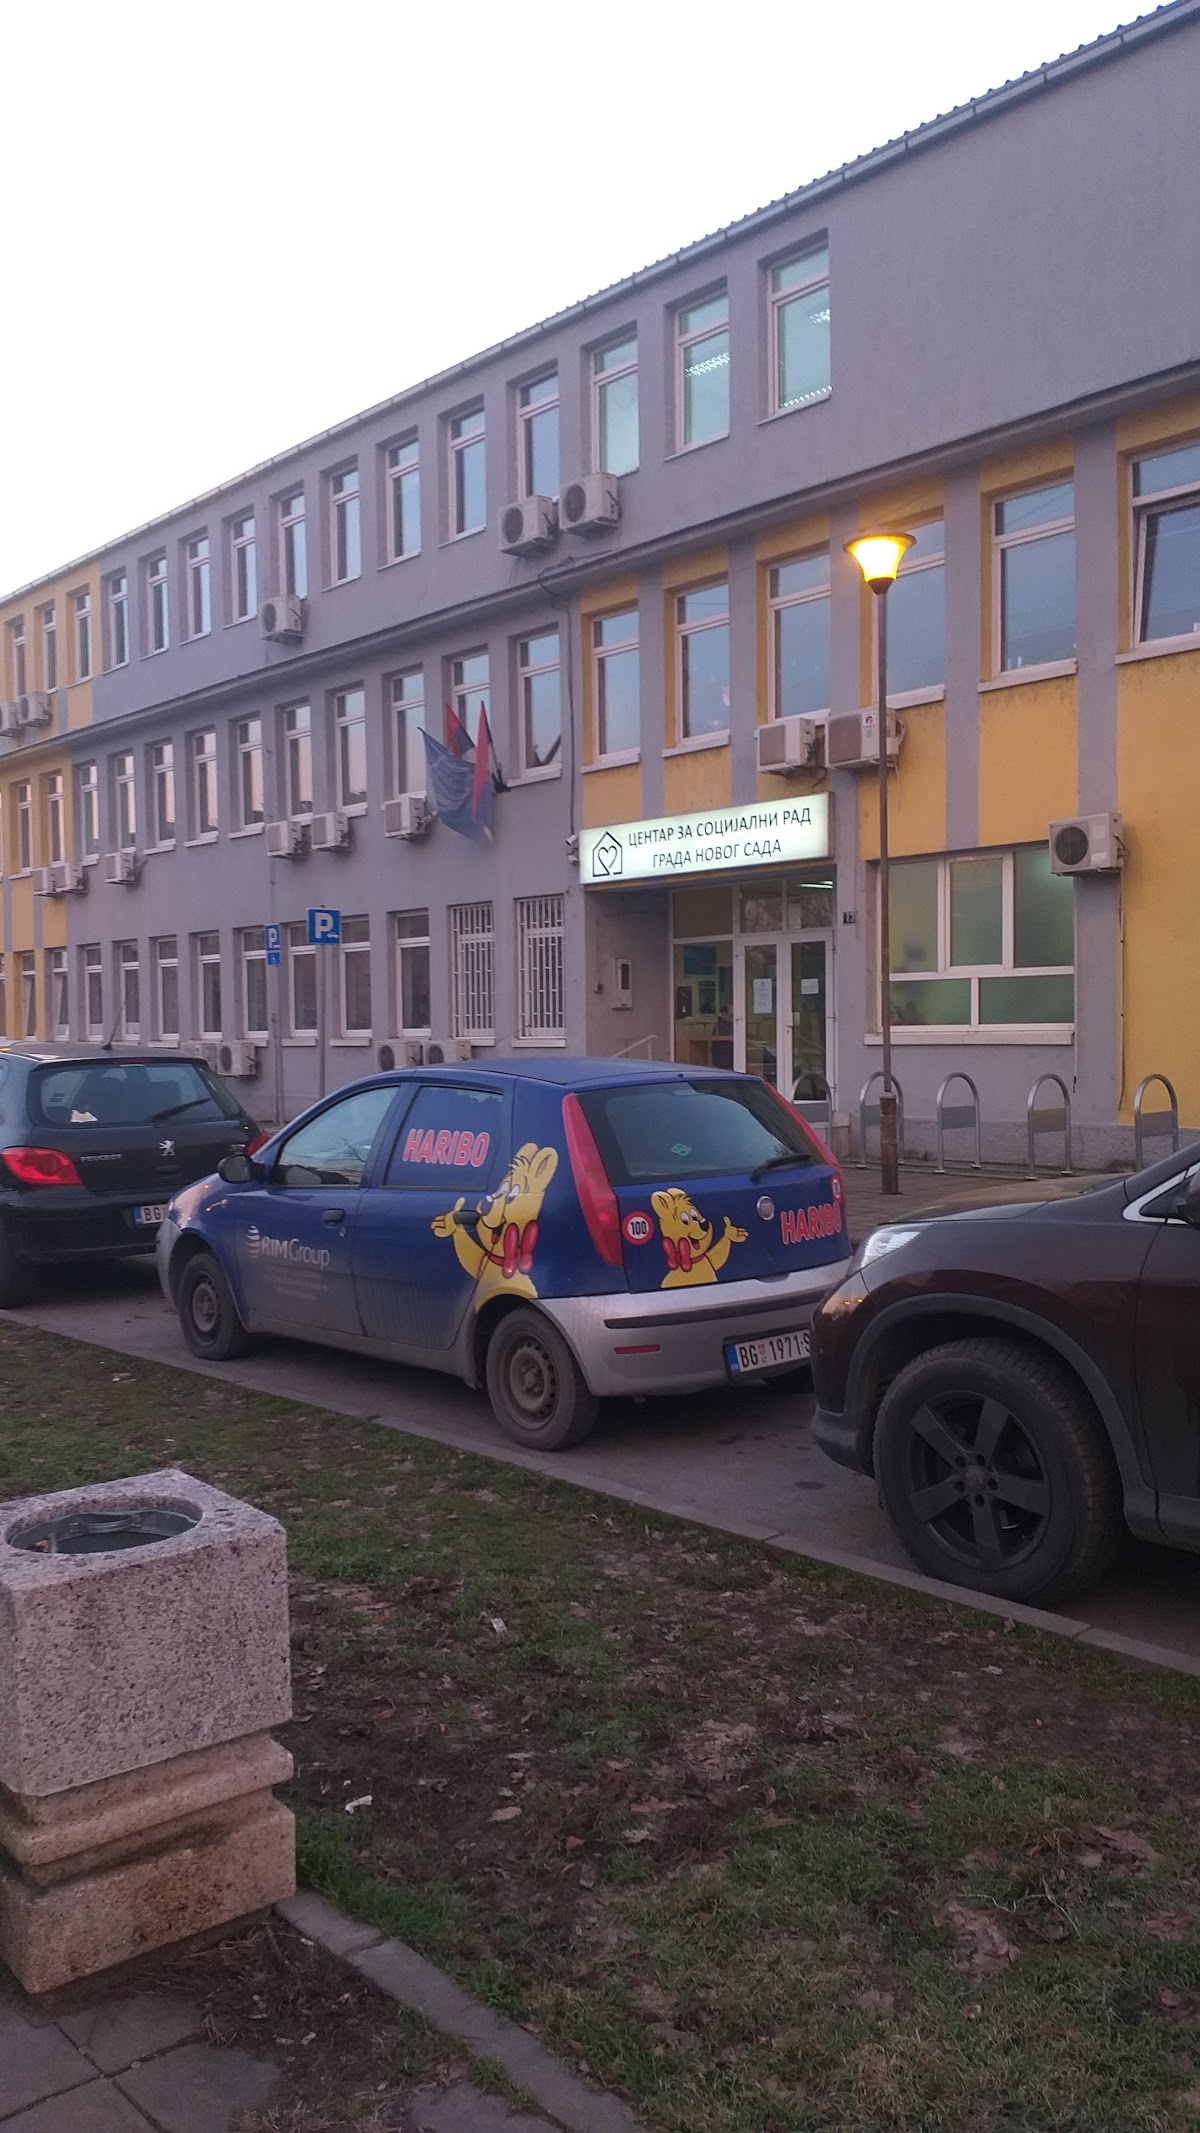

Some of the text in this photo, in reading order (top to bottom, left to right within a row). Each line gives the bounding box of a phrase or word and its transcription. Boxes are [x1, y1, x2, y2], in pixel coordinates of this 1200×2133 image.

[628, 807, 812, 848] ЦЕНТАР ЗА СОЦИЈАЛНИ РАД
[652, 838, 782, 868] ГРАДА НОВОГ САДА
[314, 912, 334, 939] P
[267, 928, 278, 949] P
[402, 1128, 490, 1168] HARIBO
[143, 1207, 162, 1222] BG
[630, 1220, 647, 1236] 100
[739, 1344, 759, 1368] BG
